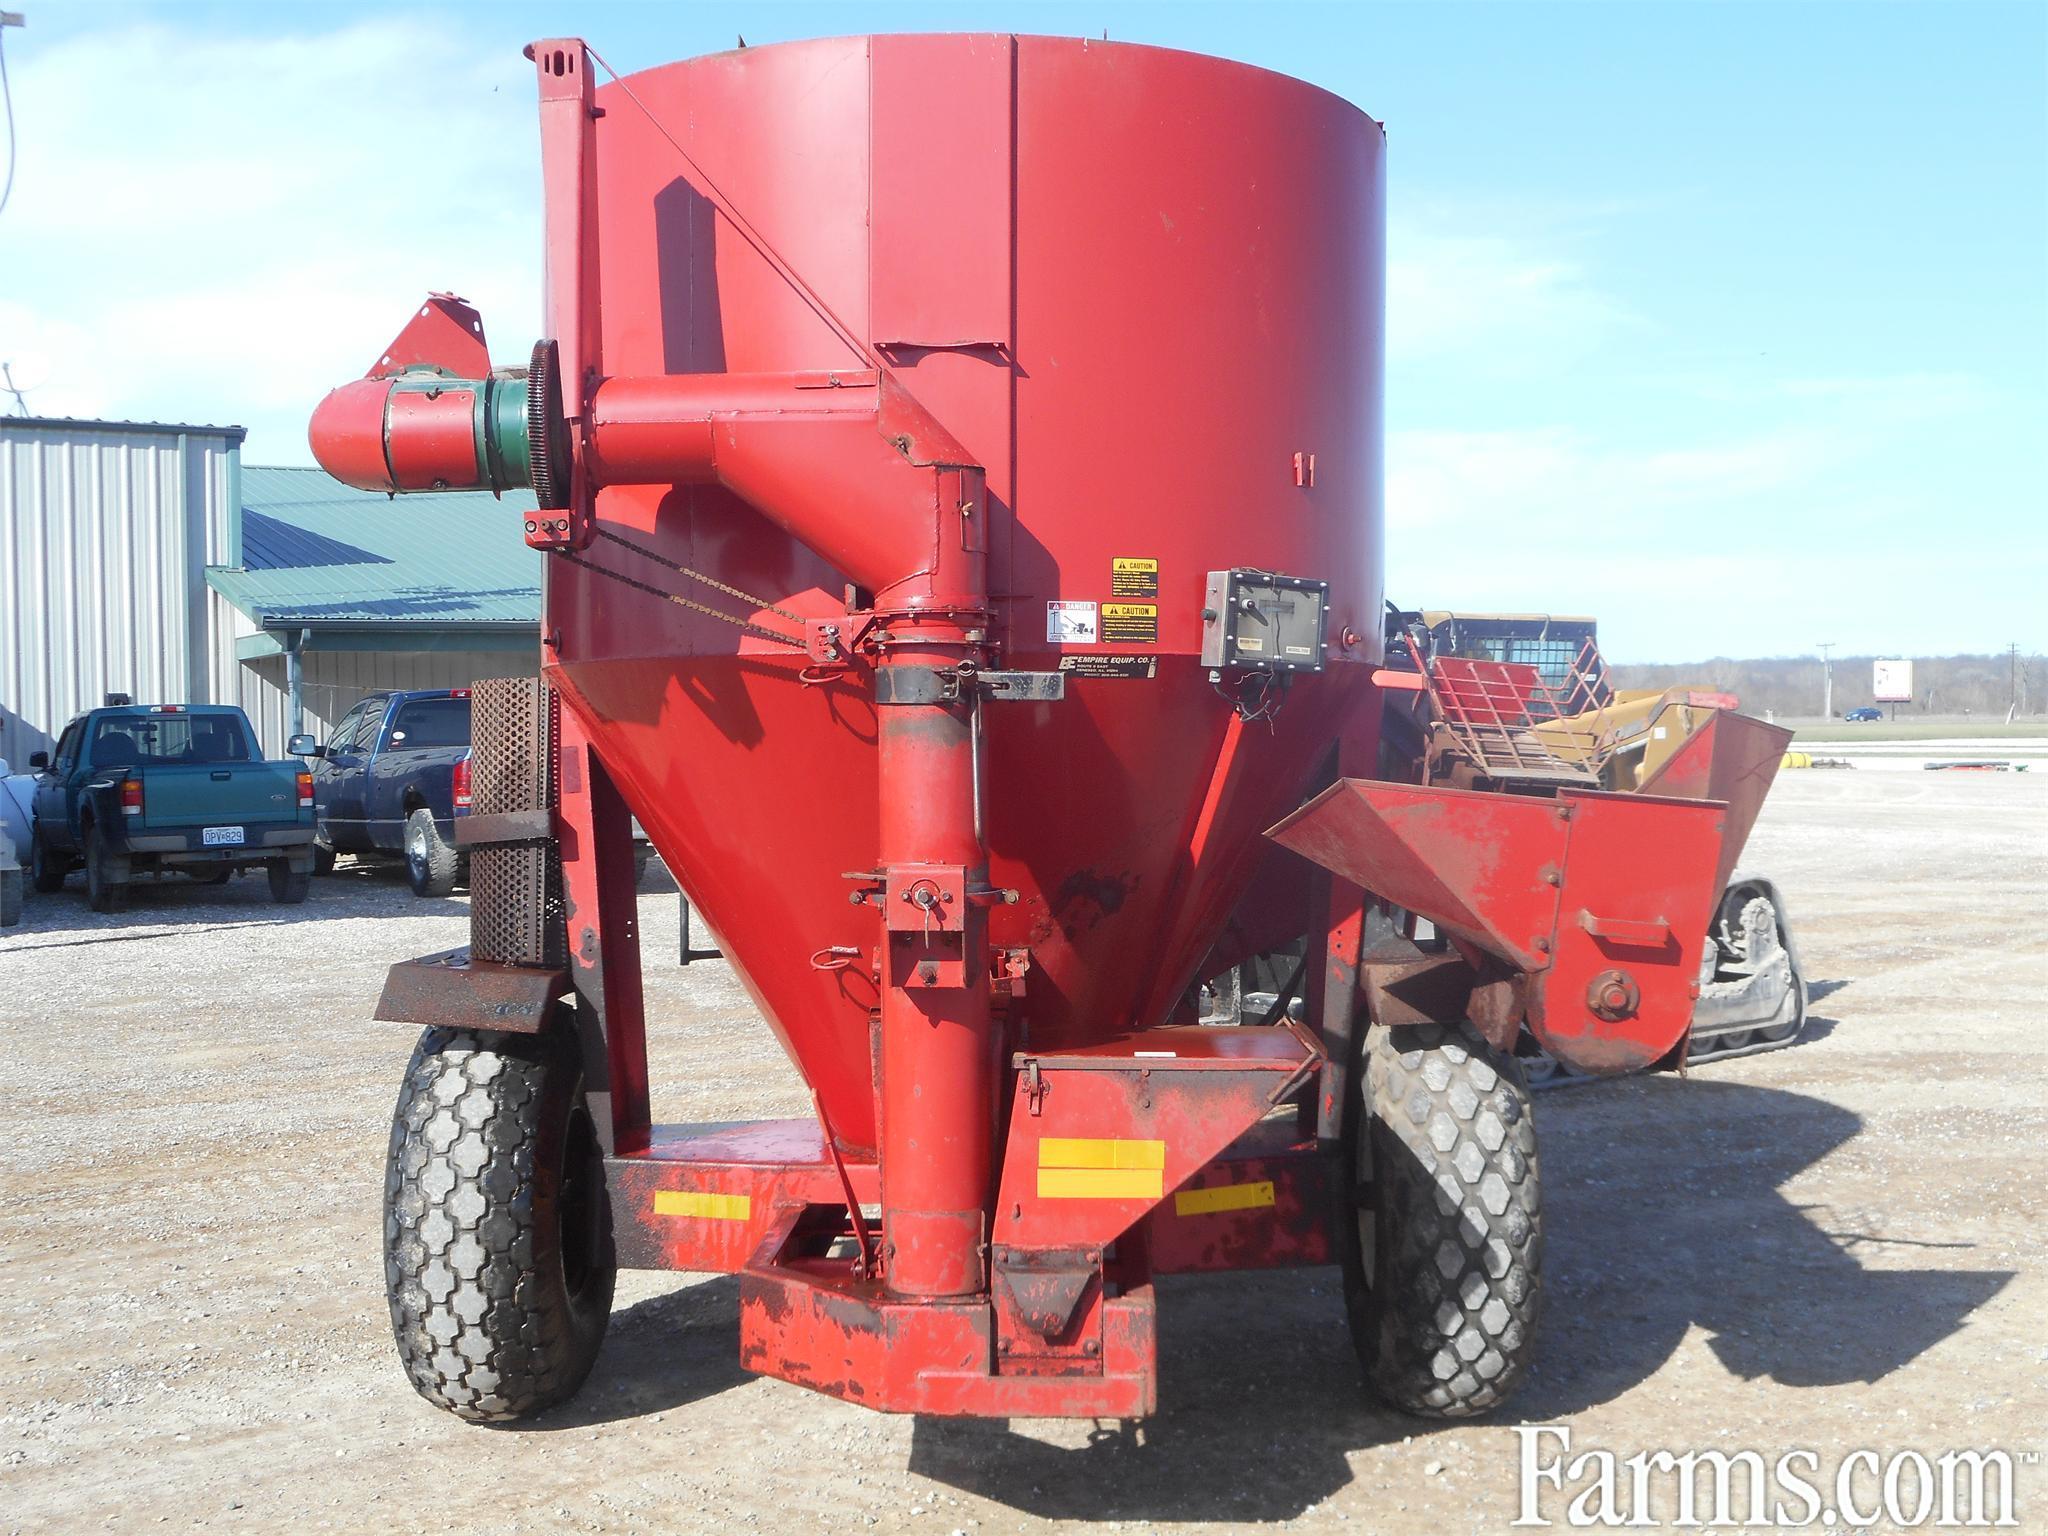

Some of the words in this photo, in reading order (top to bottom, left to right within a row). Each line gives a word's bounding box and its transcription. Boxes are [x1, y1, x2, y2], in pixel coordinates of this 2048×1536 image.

[1129, 562, 1153, 570] CAUTION
[1121, 607, 1150, 615] CAUTION
[1077, 656, 1108, 664] EMPIRE
[1110, 656, 1136, 664] EQUIP.
[1137, 656, 1150, 664] CO.
